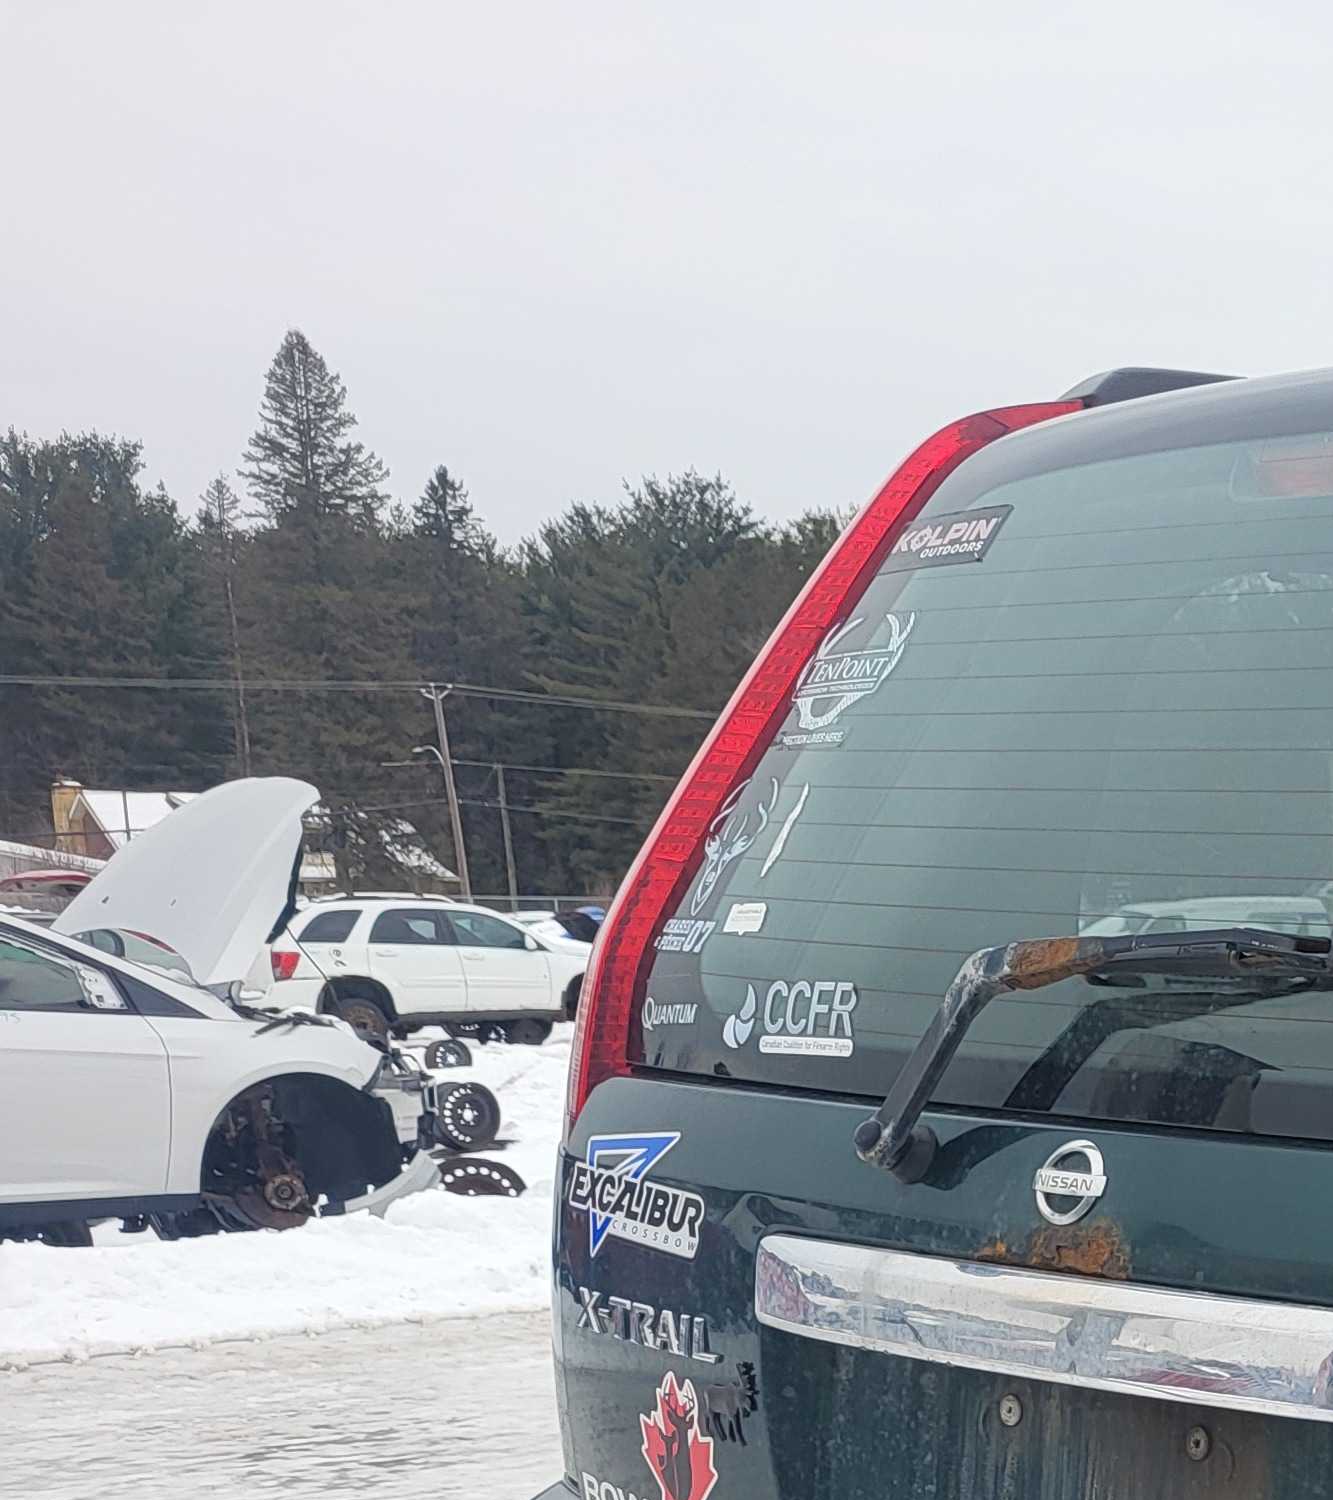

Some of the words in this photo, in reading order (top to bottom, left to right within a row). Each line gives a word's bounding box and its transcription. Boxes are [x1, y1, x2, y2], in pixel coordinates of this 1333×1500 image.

[892, 518, 1000, 554] KOLPIN
[920, 541, 984, 559] OUTDOORS
[682, 920, 716, 953] 07
[764, 980, 857, 1037] CCFR
[1039, 1173, 1094, 1192] NISSAN
[571, 1166, 702, 1238] EXCALIBUR
[576, 1286, 724, 1365] X-TRAIL
